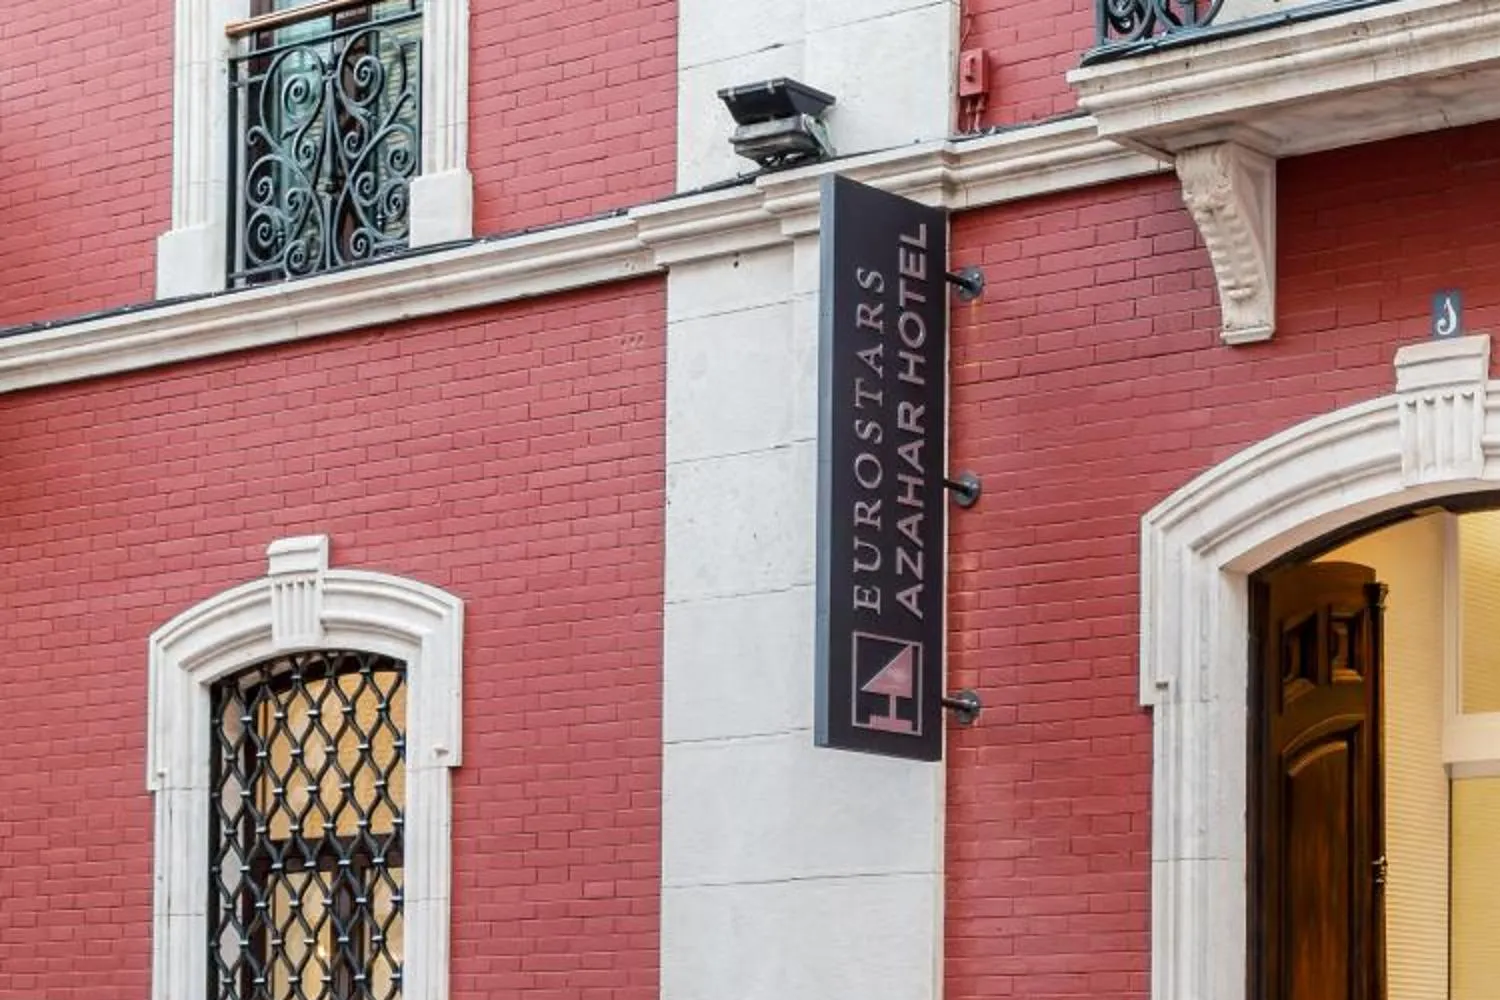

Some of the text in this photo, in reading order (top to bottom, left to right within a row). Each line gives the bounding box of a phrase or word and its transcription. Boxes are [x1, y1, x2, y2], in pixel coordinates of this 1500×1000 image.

[853, 266, 885, 615] EUROSTARS
[895, 223, 927, 620] AZAHAR HOTEL
